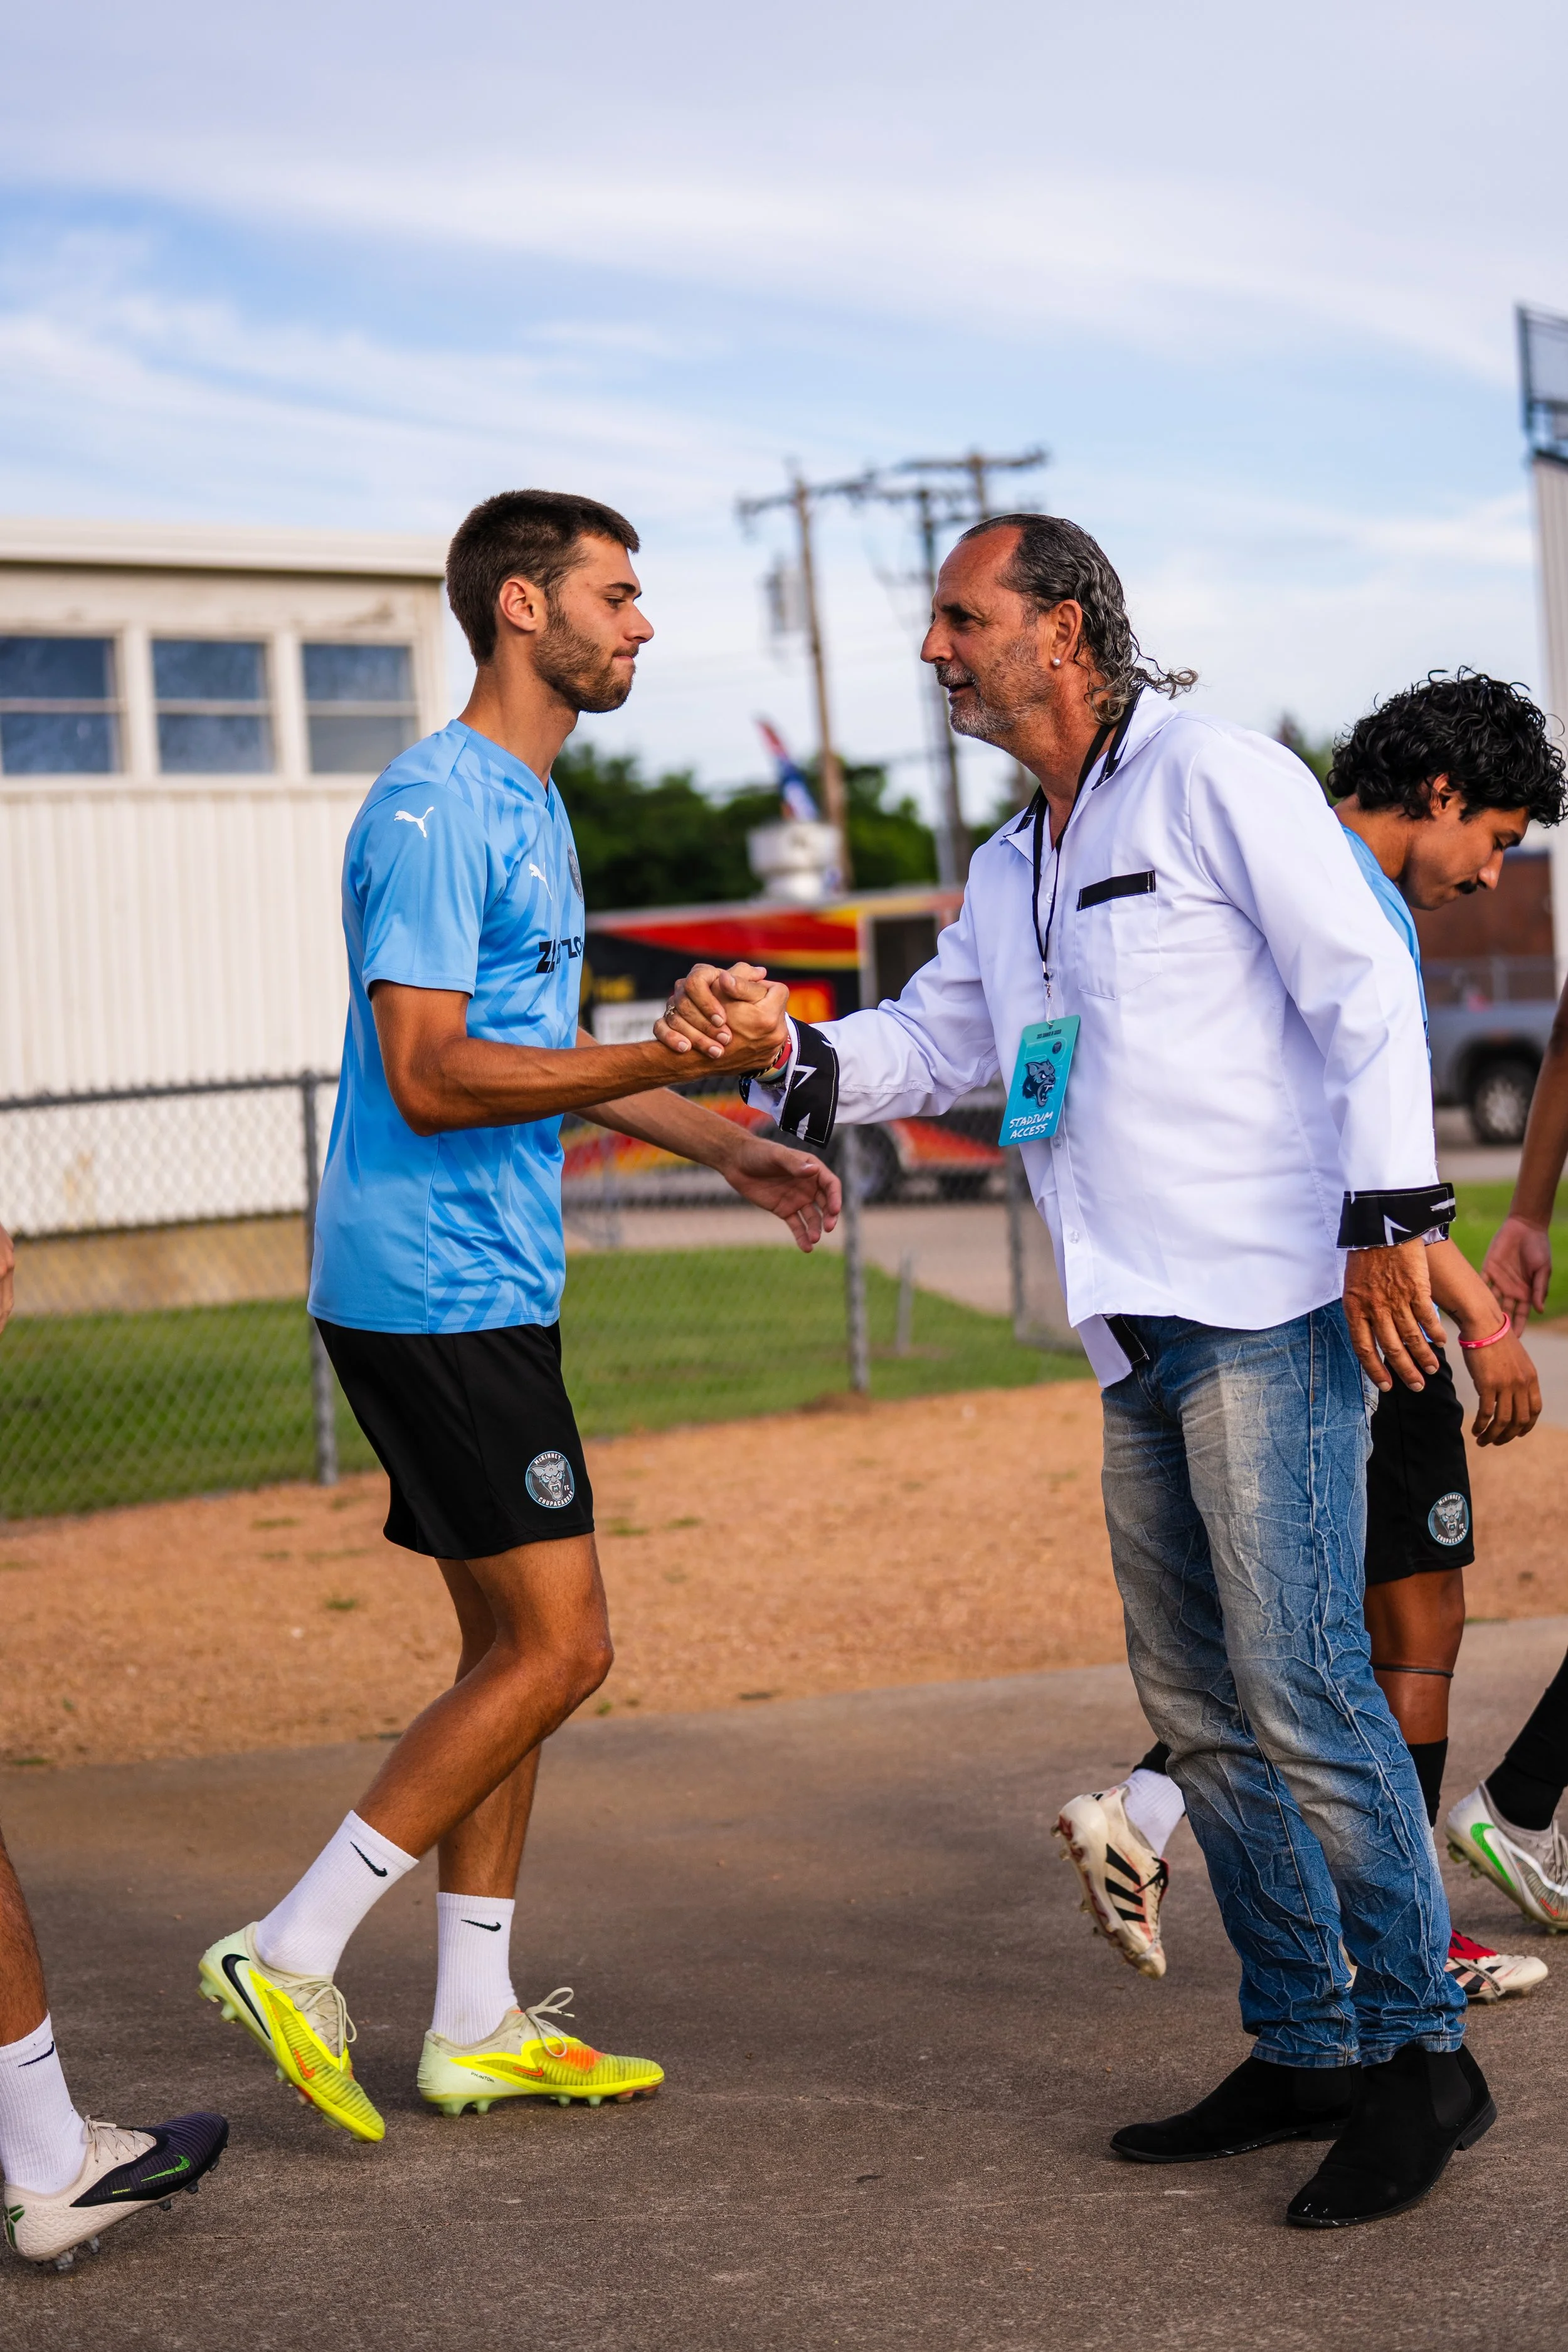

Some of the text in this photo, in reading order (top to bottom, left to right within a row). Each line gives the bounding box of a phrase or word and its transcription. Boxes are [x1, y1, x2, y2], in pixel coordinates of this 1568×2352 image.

[1009, 1111, 1053, 1129] STADIUM
[1009, 1123, 1048, 1140] ACCESS
[534, 1453, 561, 1465] McKINNEY
[538, 1490, 573, 1507] CHUPACABRAS
